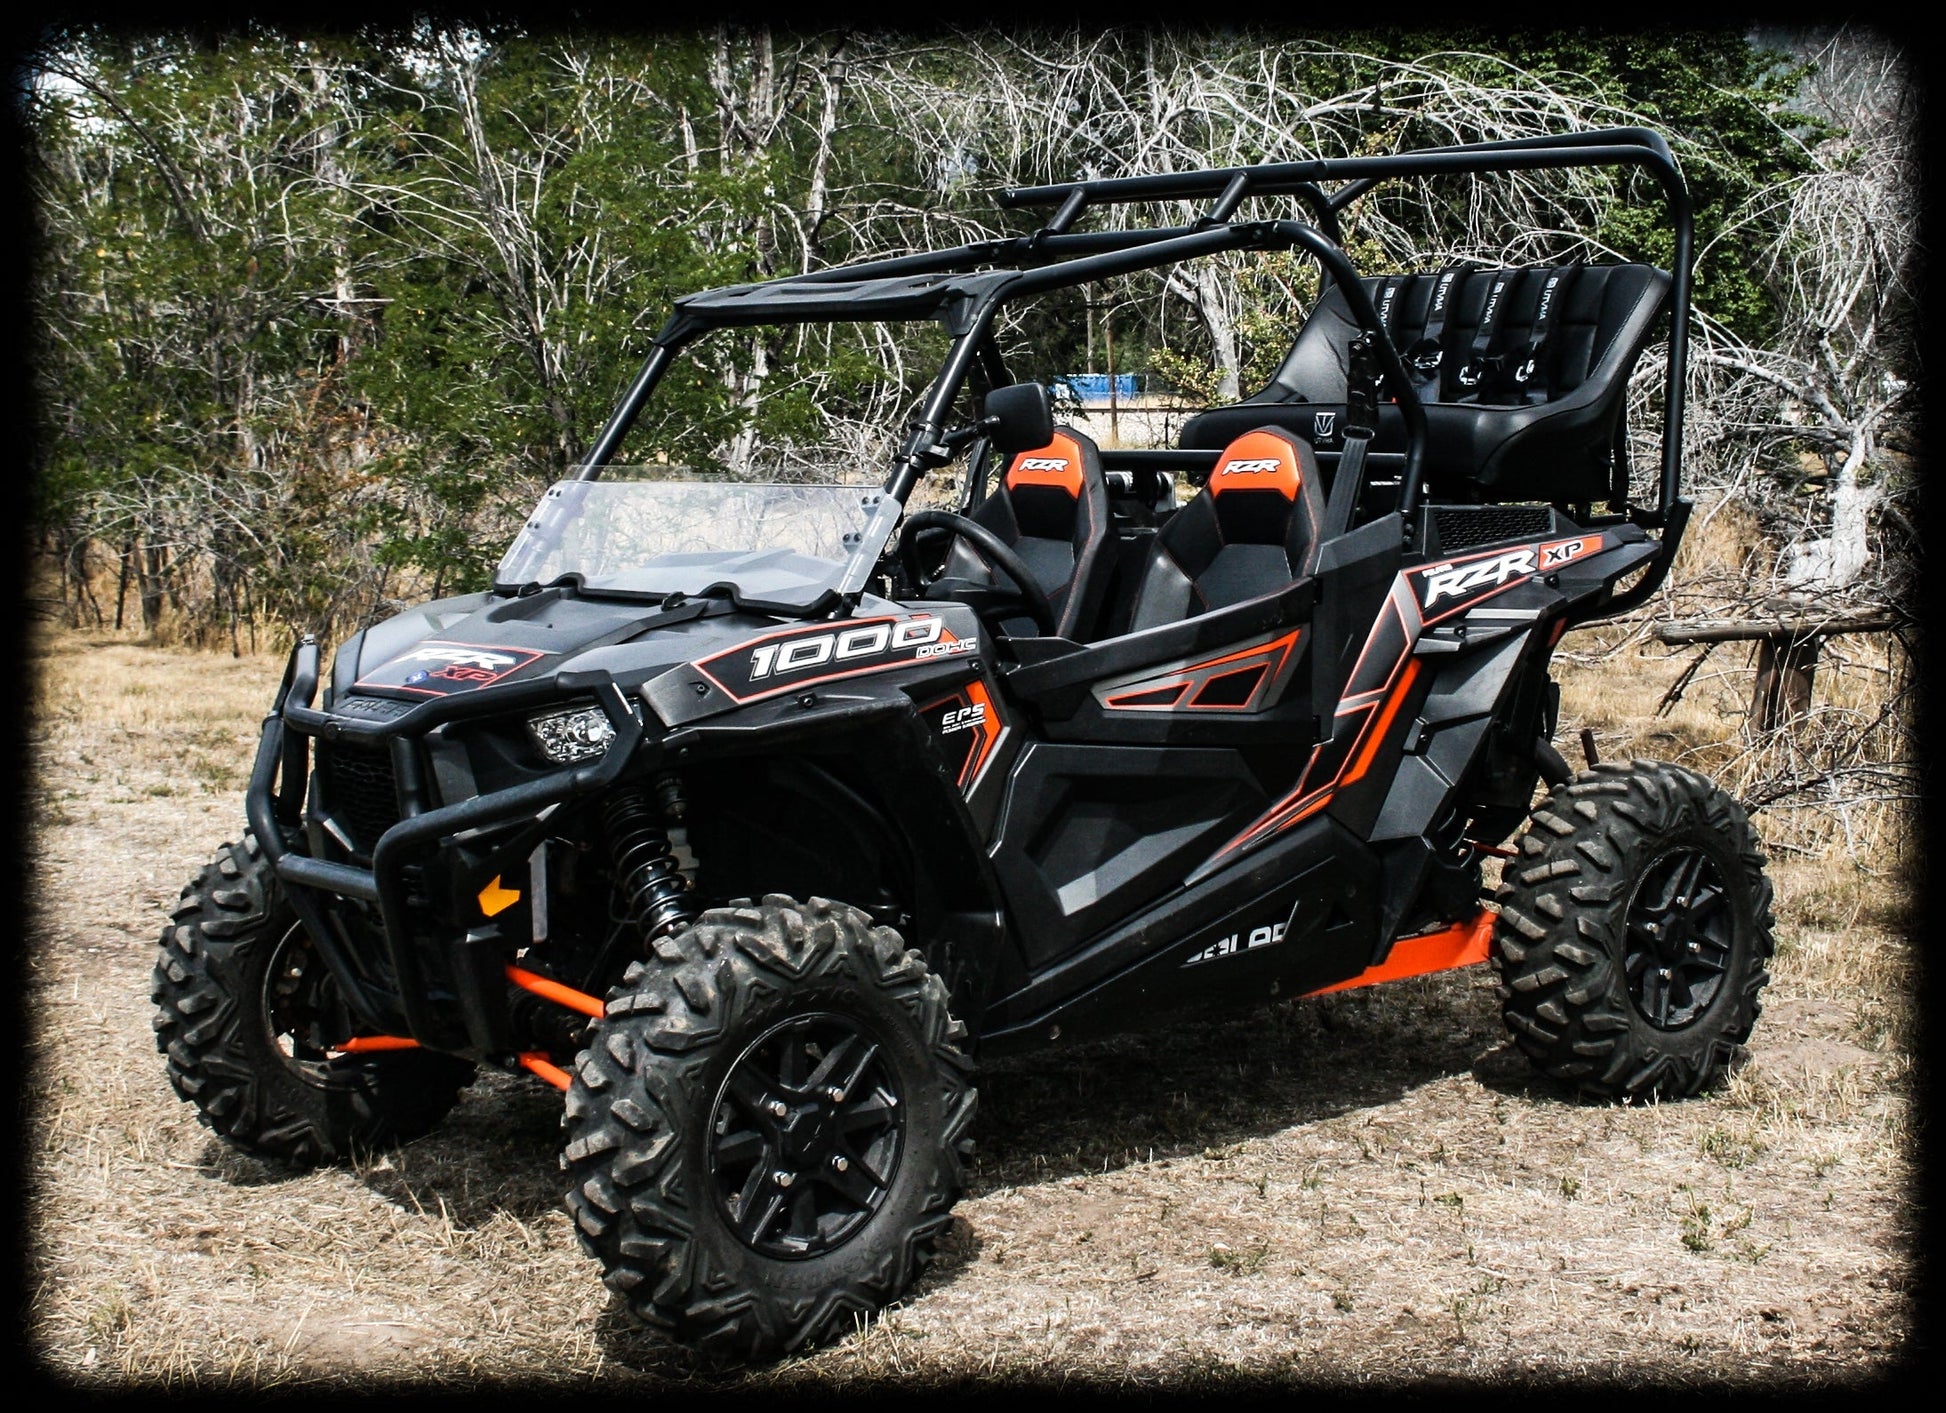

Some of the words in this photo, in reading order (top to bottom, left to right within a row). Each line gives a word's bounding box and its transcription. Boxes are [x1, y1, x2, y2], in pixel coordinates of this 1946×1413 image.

[1018, 458, 1069, 472] RZR
[1221, 458, 1281, 476] RZR
[1424, 549, 1537, 609] RZR
[1543, 540, 1584, 568] XP
[750, 616, 944, 682] 1000
[942, 702, 986, 726] EPS
